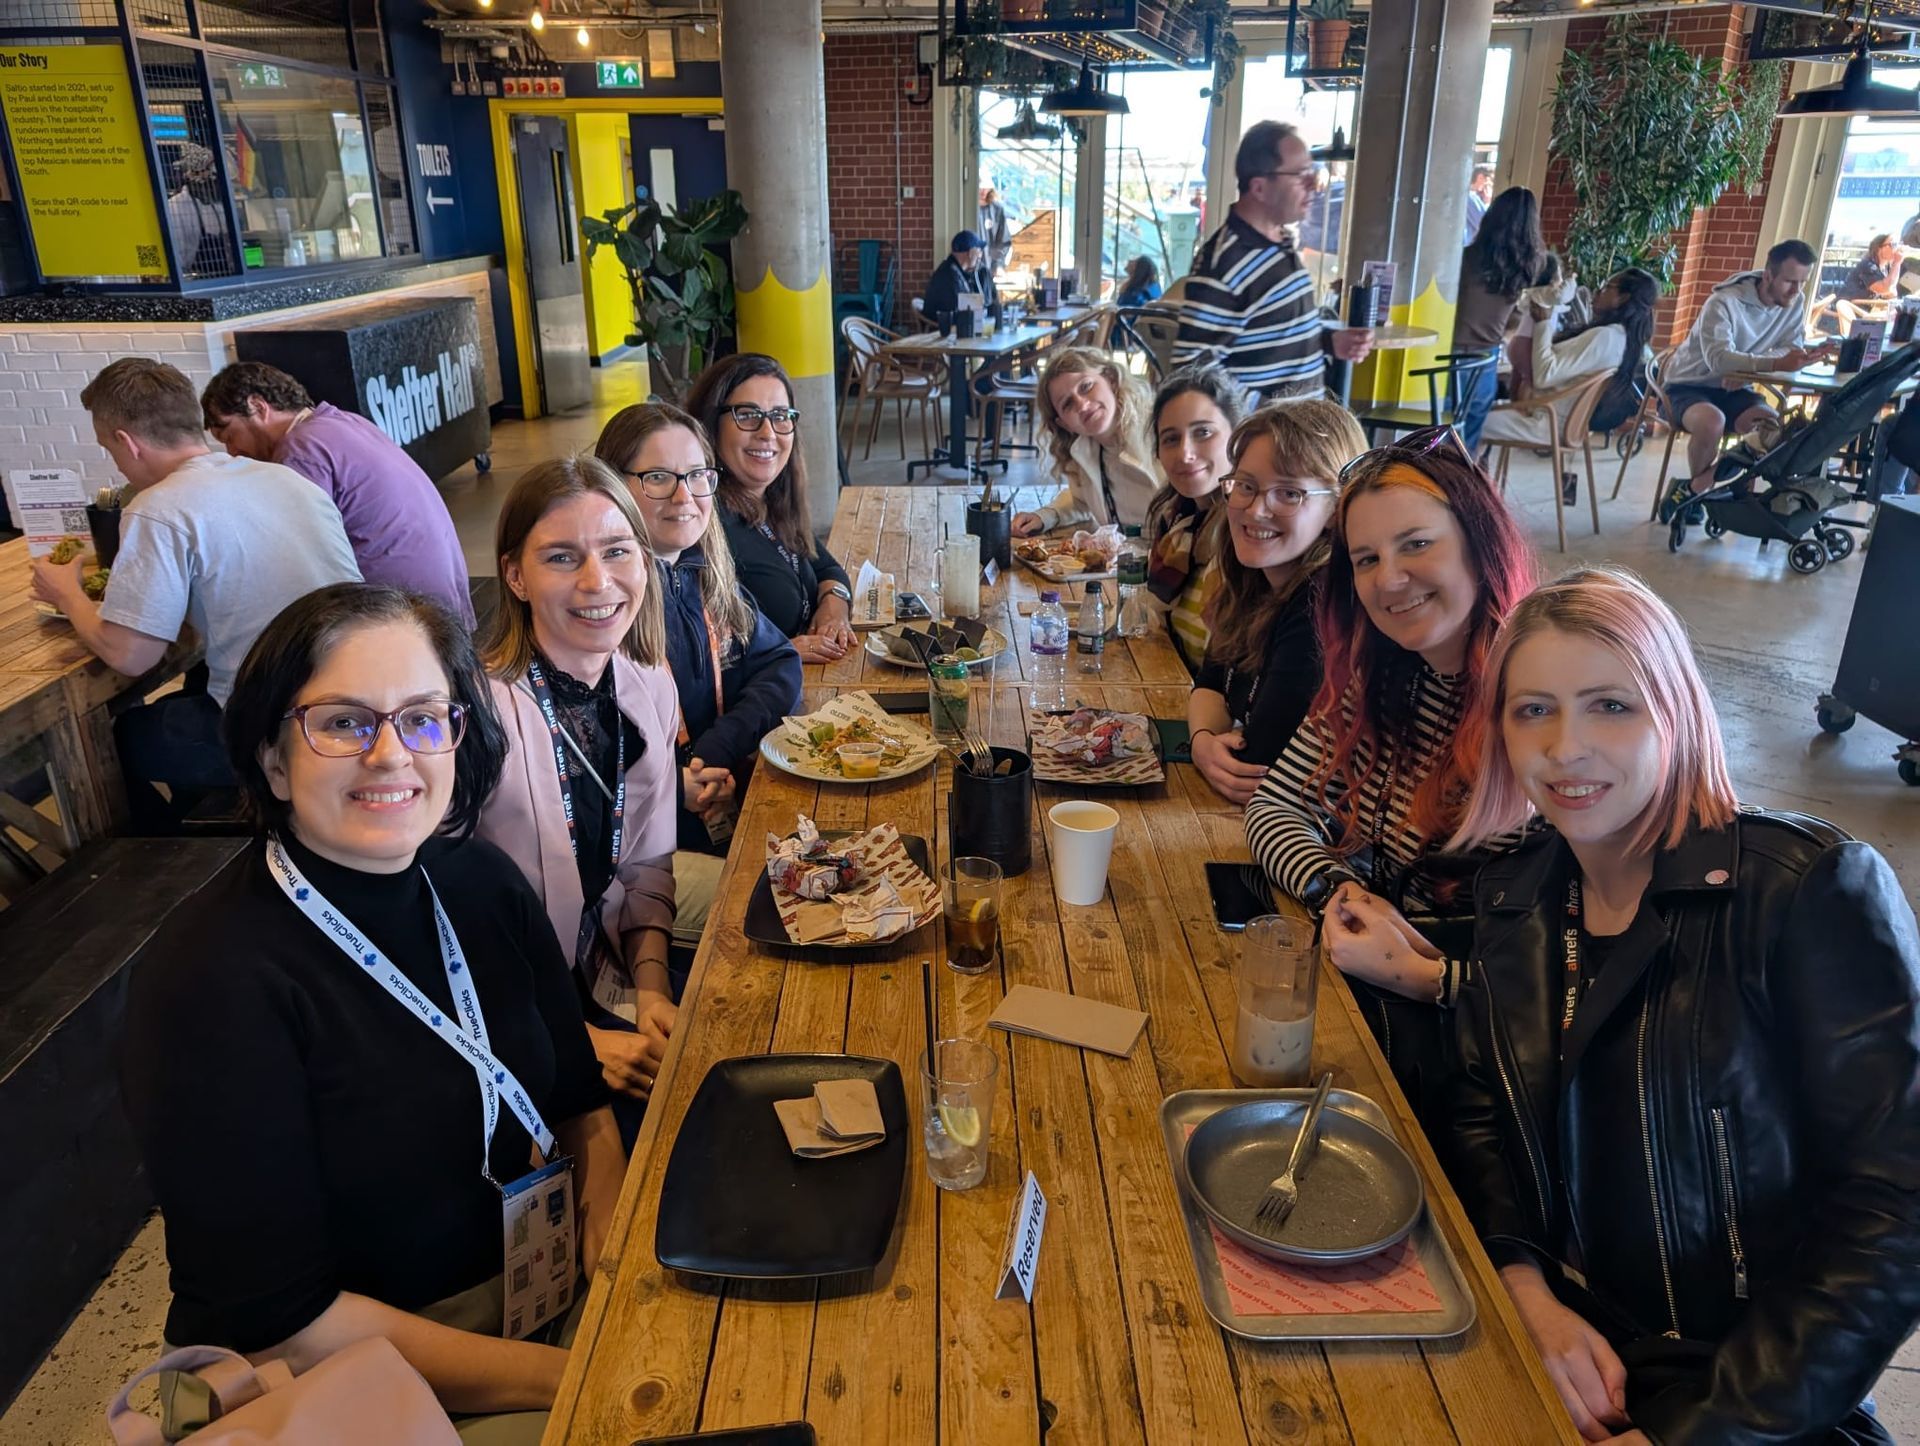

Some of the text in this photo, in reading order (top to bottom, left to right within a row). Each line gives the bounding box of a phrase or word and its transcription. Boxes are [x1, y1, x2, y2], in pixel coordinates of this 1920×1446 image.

[0, 53, 48, 70] Our Story
[8, 95, 17, 104] by
[19, 94, 36, 102] Paul
[37, 94, 52, 102] and
[70, 94, 88, 102] after
[90, 94, 108, 104] long
[29, 83, 57, 91] started
[57, 83, 66, 91] in
[66, 83, 89, 92] 2021,
[103, 85, 114, 93] up
[47, 114, 62, 123] The
[63, 116, 78, 124] pair
[79, 115, 97, 123] took
[63, 104, 104, 114] hospitality
[15, 126, 49, 134] rundown
[17, 136, 103, 146] Worthing seafront and
[20, 146, 66, 154] transformed
[67, 146, 75, 154] it
[75, 146, 90, 154] into
[107, 146, 116, 154] of
[116, 146, 130, 154] the
[22, 156, 125, 166] top Mexican eateries in the
[416, 143, 451, 176] TOILETS
[31, 197, 128, 206] Scan the QR code to read
[34, 207, 47, 216] the
[47, 207, 60, 216] full
[366, 365, 441, 447] Shelter
[529, 661, 545, 687] ahre
[543, 698, 559, 735] ahrefs
[556, 745, 569, 782] ahrefs
[562, 792, 575, 830] ahrefs
[614, 782, 624, 817] ahrefs
[611, 828, 621, 864] ahrefs
[1565, 879, 1579, 916] ahrefs
[321, 910, 365, 954] TrueClicks
[436, 909, 456, 959] TrueClicks
[1564, 928, 1579, 972] ahrefs
[388, 973, 430, 1017] TrueClicks
[1562, 986, 1577, 1030] ahrefs
[462, 988, 482, 1041] TrueClicks
[455, 1034, 495, 1073] TrueClicks
[486, 1080, 496, 1129] TrueClick
[513, 1090, 536, 1126] TrueClicks
[1017, 1181, 1043, 1286] Reserved
